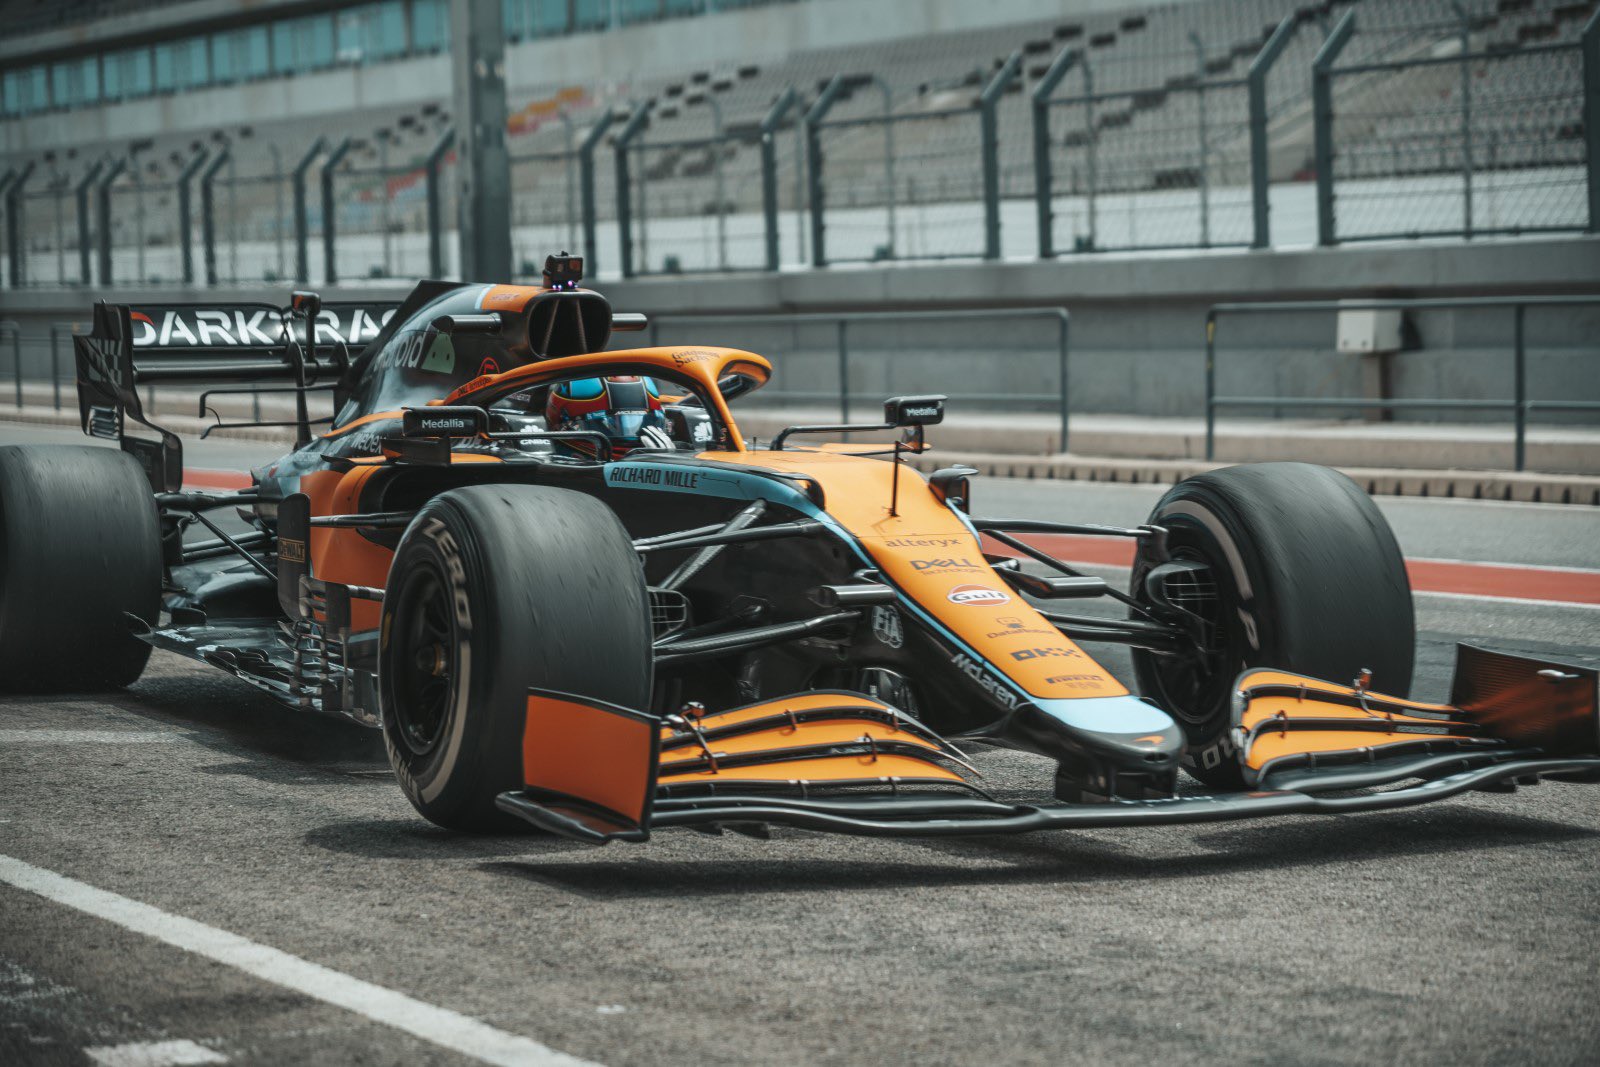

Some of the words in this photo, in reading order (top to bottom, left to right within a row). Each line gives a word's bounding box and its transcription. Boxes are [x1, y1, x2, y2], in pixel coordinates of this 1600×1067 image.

[906, 406, 938, 417] Medallia
[421, 418, 464, 428] Medallia
[610, 467, 662, 485] RICHARD
[664, 470, 699, 489] MILLE
[885, 538, 962, 548] alteryx
[909, 558, 981, 571] DELL
[422, 517, 473, 630] ZERO
[951, 592, 1006, 602] Gulf
[951, 653, 1018, 710] McLaren
